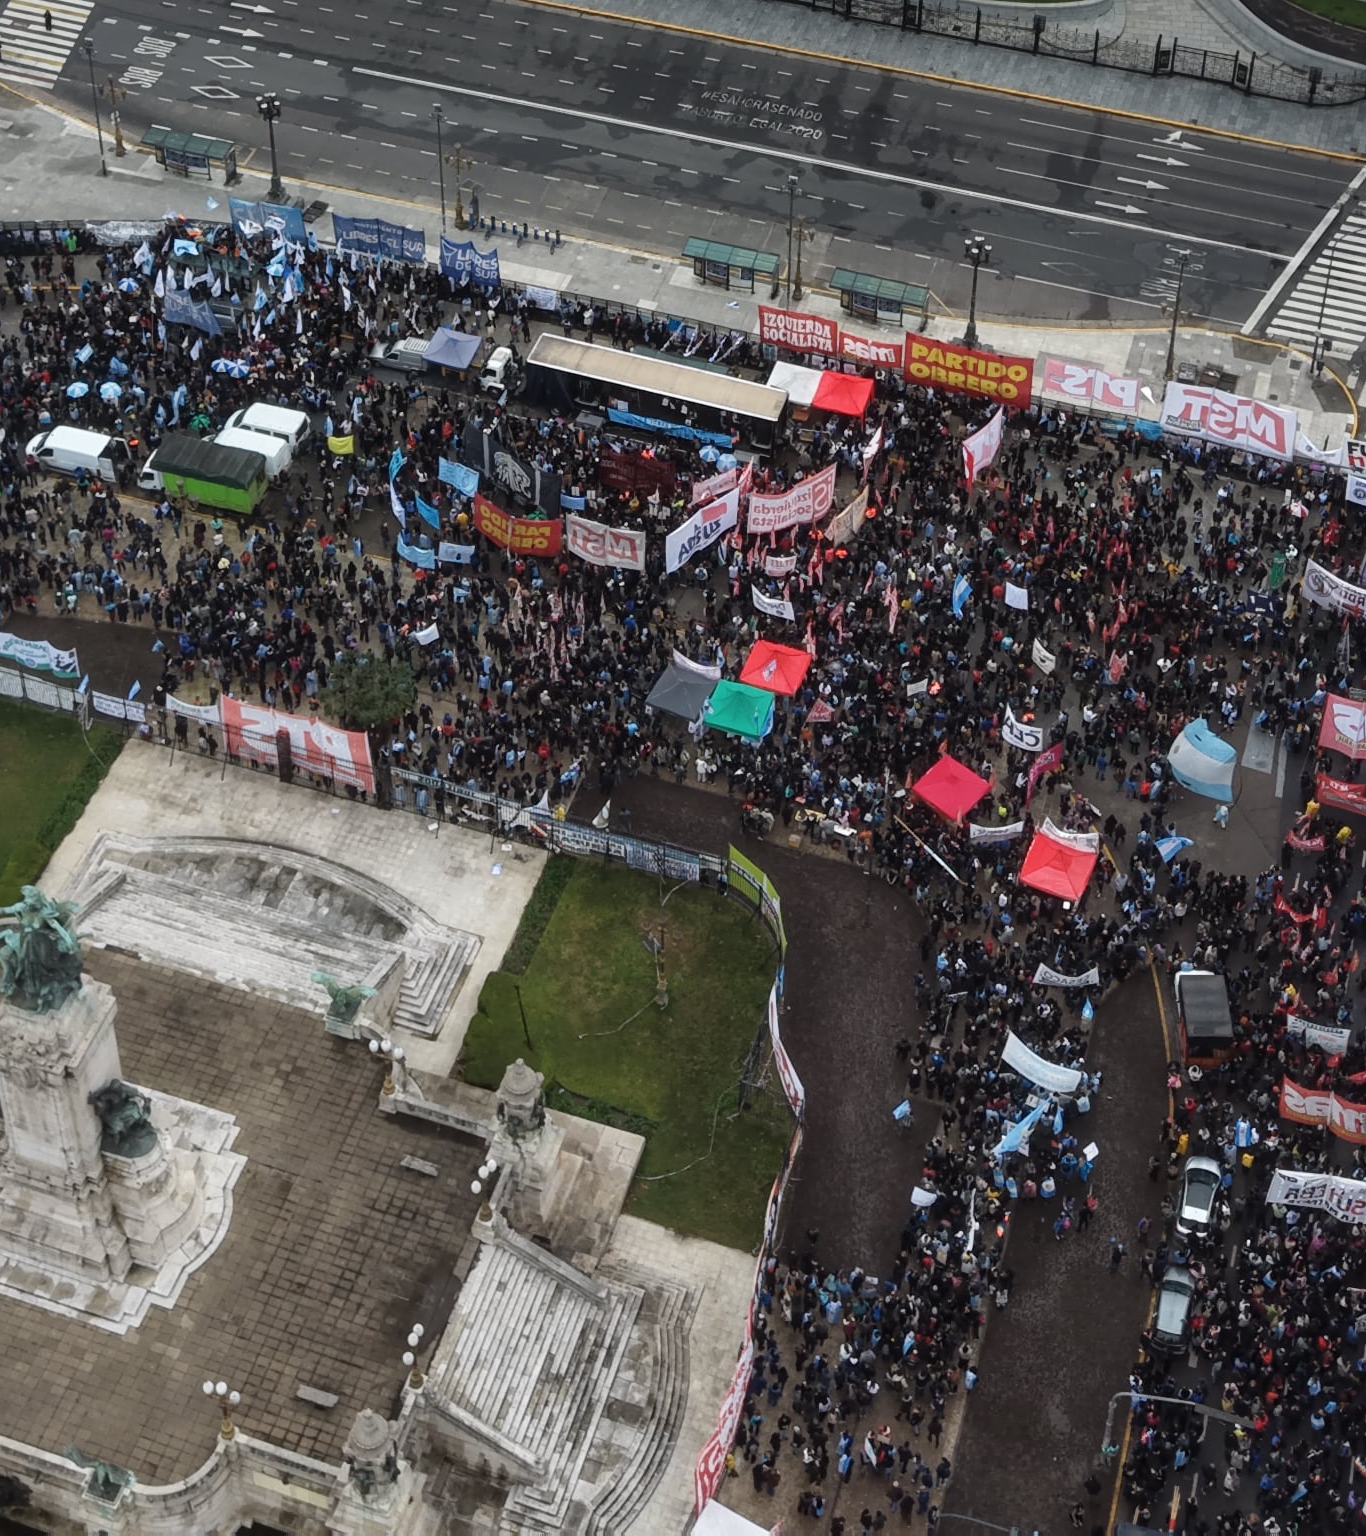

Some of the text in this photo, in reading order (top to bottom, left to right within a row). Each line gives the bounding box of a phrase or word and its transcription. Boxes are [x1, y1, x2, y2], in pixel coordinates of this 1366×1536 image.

[133, 36, 176, 58] BUS
[118, 66, 163, 89] BUS
[402, 240, 423, 254] SUR
[475, 268, 497, 281] SUR
[763, 312, 832, 339] IZQUIERDA
[763, 327, 833, 353] SOCIALISTA
[911, 342, 1028, 382] PARTIDO
[909, 363, 1019, 399] OBRERO
